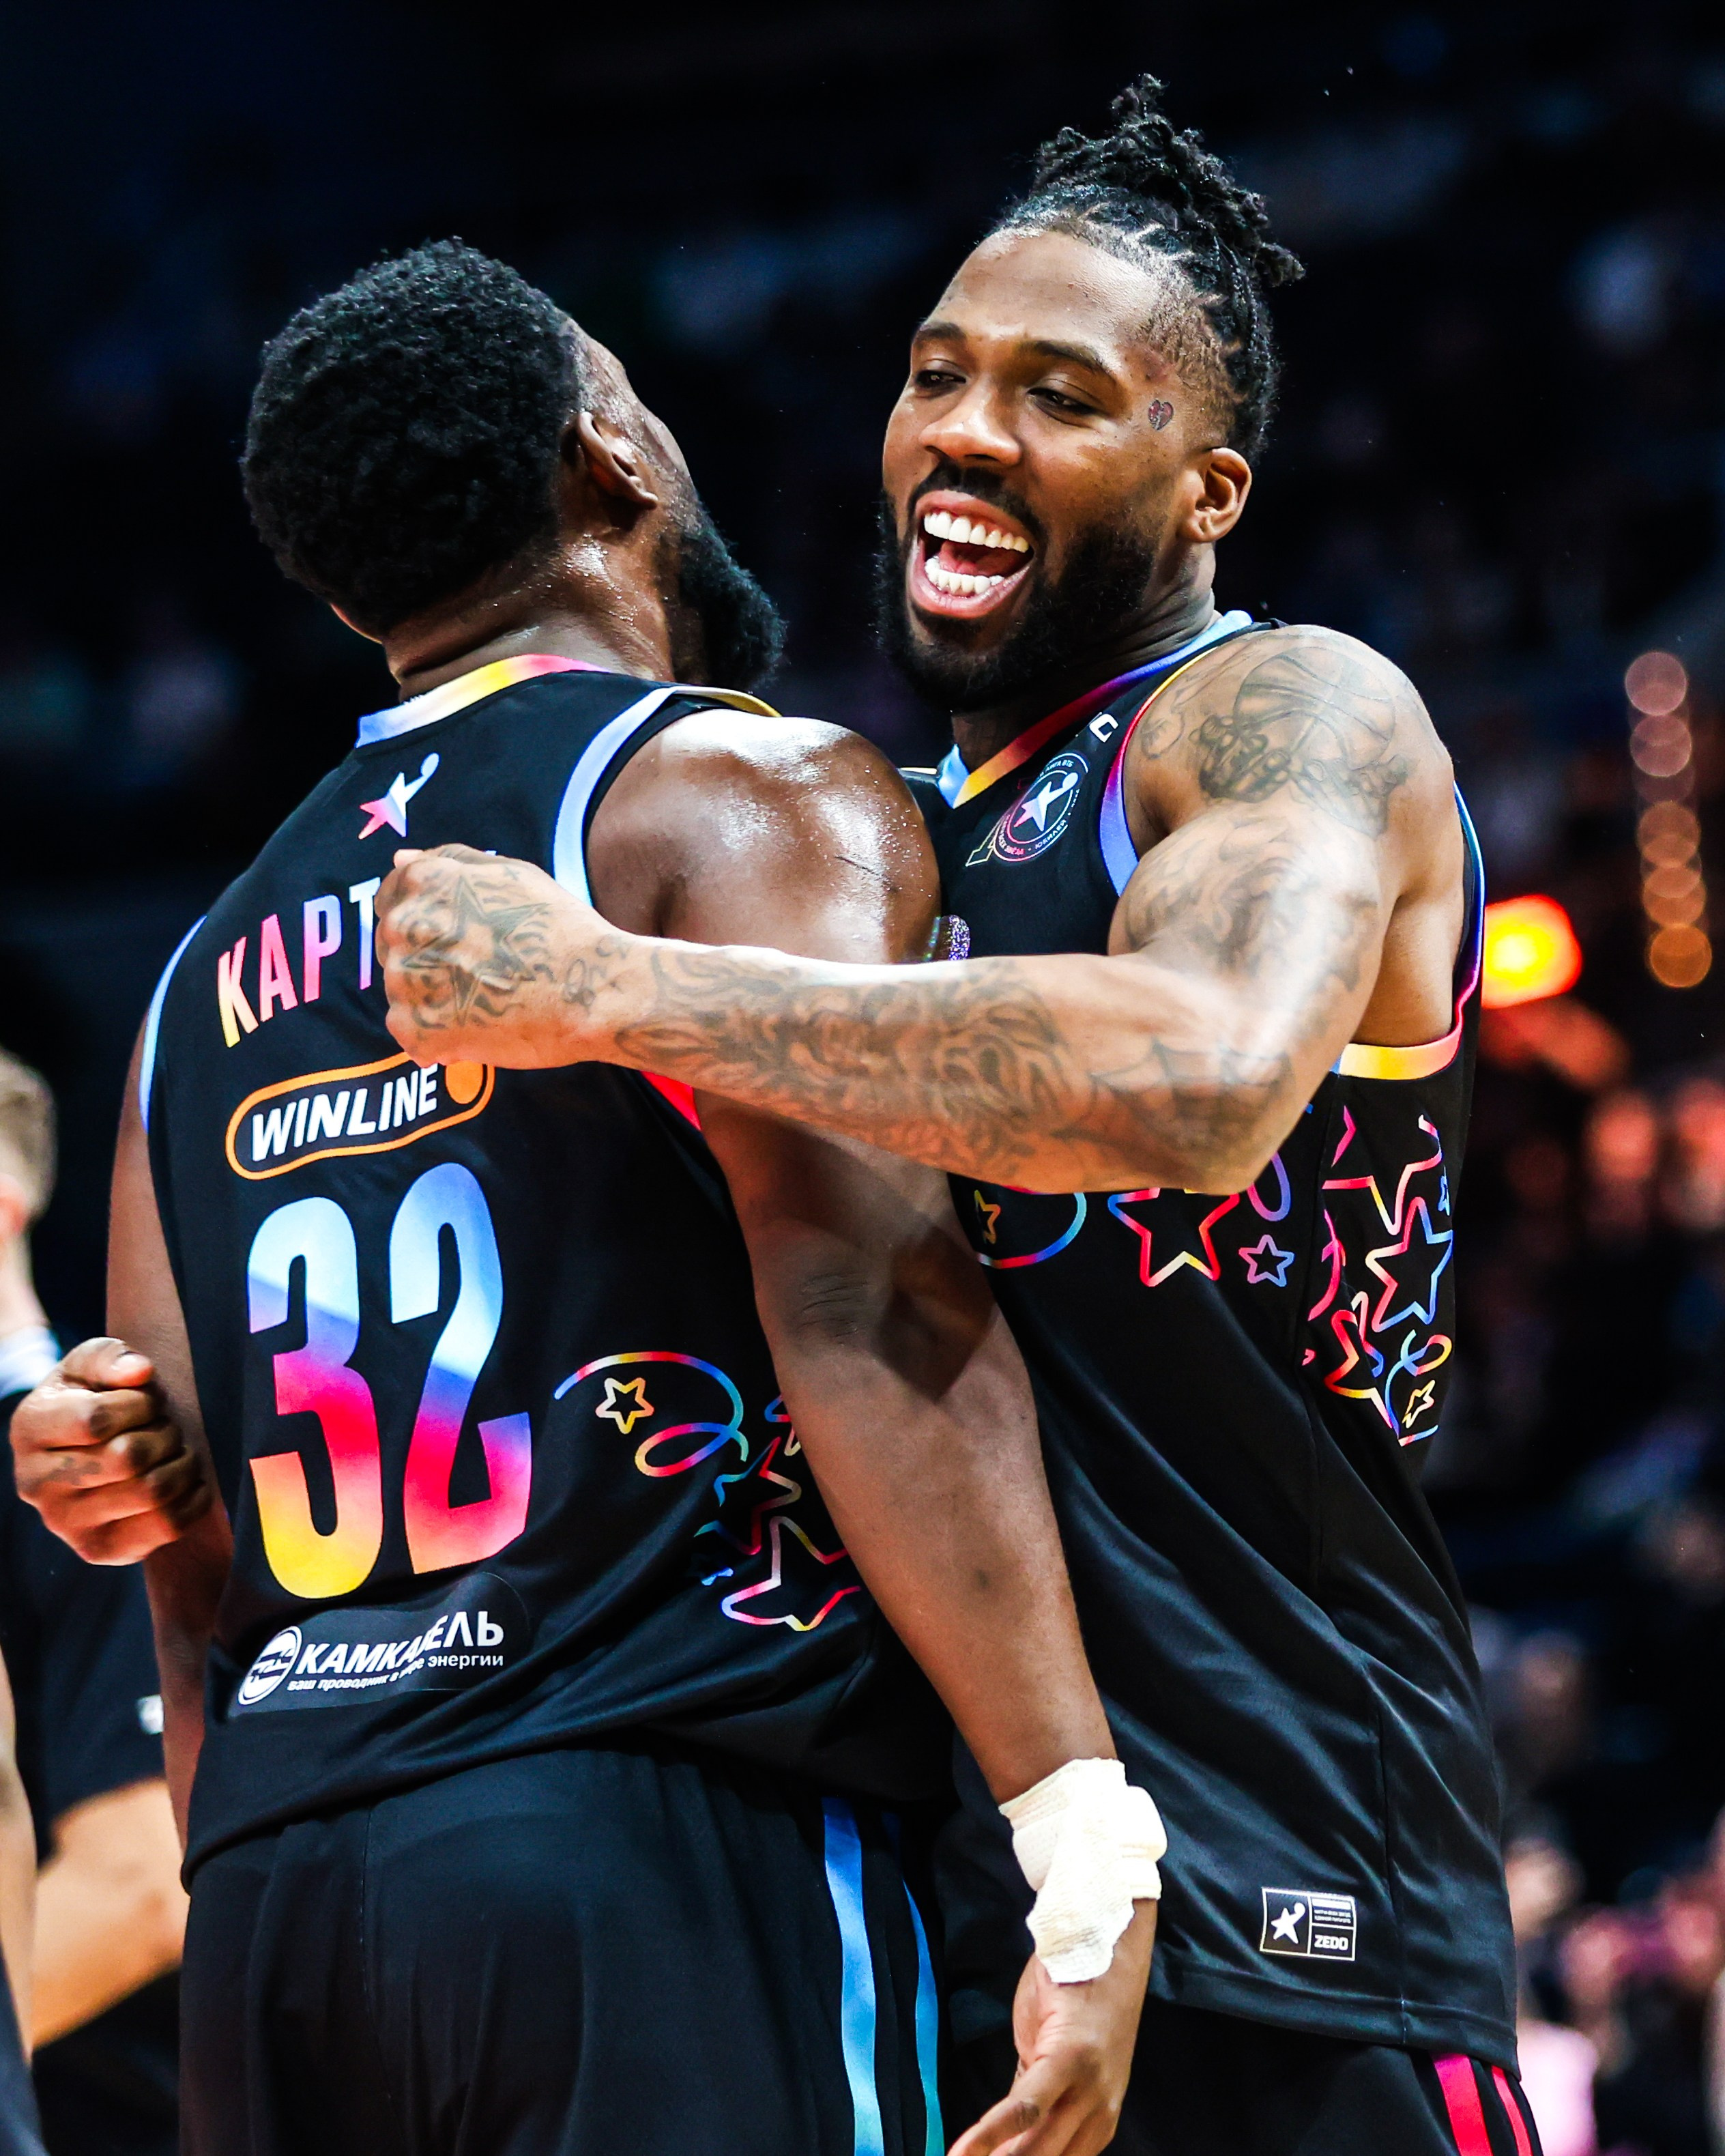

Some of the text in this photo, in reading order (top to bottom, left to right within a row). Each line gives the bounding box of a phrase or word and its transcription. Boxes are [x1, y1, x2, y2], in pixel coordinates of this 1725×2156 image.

[217, 876, 381, 1048] КАРТ
[251, 1062, 439, 1162] WINLINE
[247, 1162, 532, 1599] 32
[427, 1653, 504, 1669] энергии
